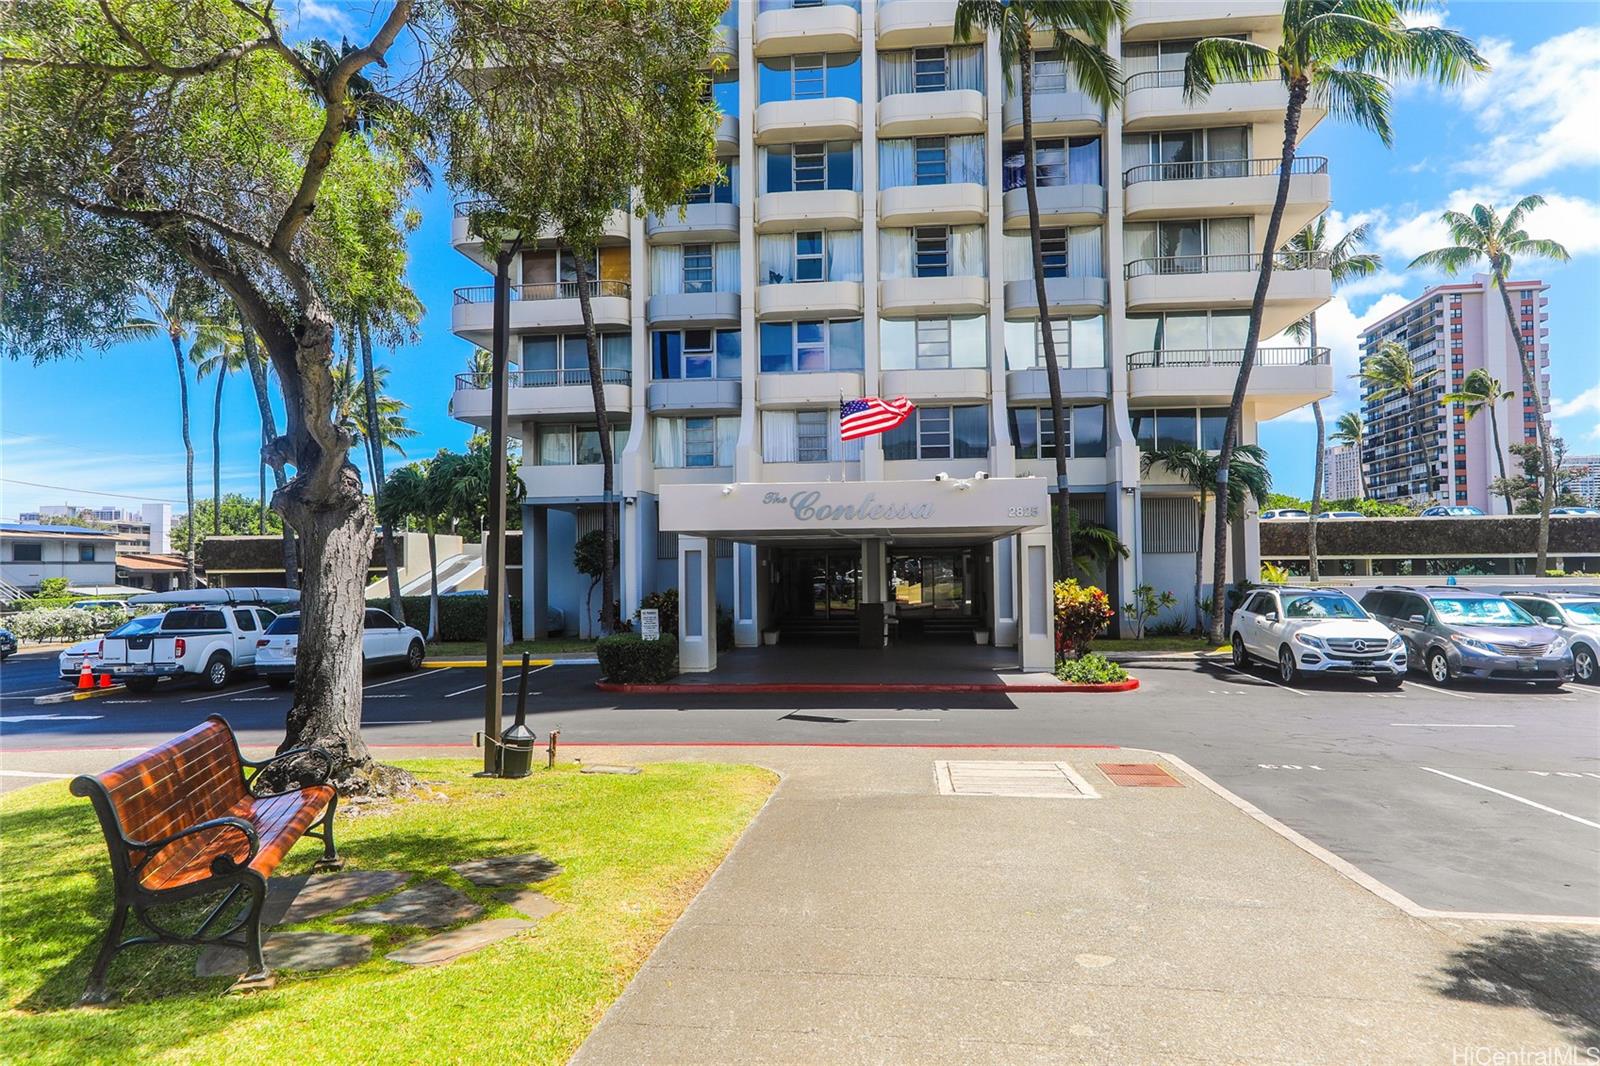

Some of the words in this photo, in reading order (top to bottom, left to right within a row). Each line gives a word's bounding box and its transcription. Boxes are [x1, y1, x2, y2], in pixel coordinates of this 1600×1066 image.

[762, 491, 787, 505] The
[789, 490, 935, 521] Contessa
[1008, 506, 1039, 518] 2825
